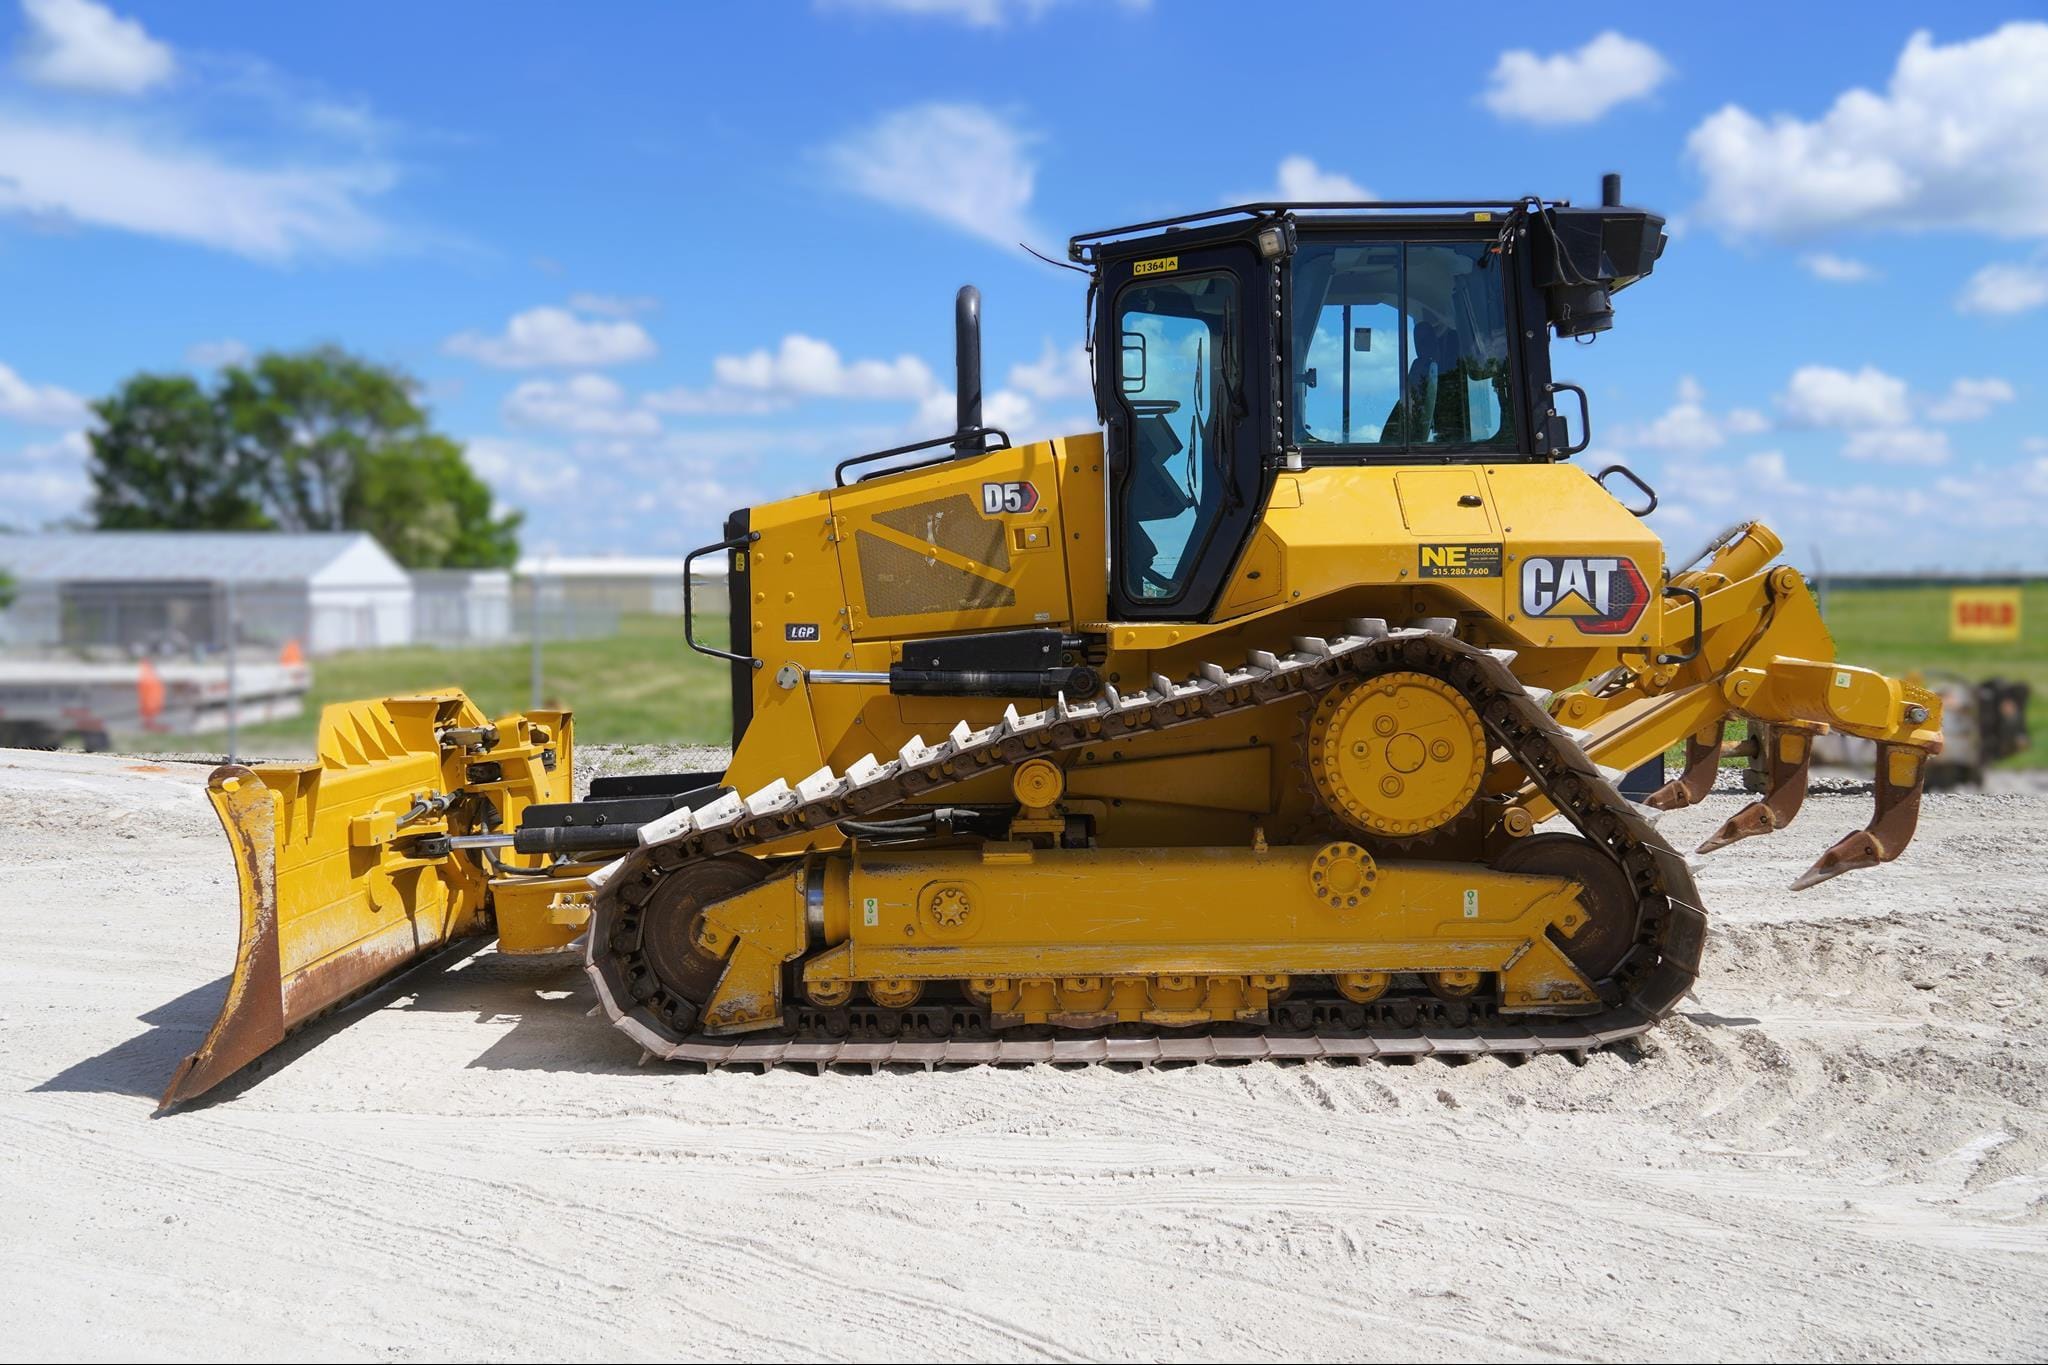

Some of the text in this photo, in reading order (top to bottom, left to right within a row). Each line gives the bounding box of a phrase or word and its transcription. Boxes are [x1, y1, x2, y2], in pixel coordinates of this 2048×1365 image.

[1135, 261, 1164, 272] C1364
[984, 483, 1021, 513] D5
[1422, 547, 1467, 566] NE
[1522, 558, 1618, 616] CAT
[791, 626, 815, 638] LGP
